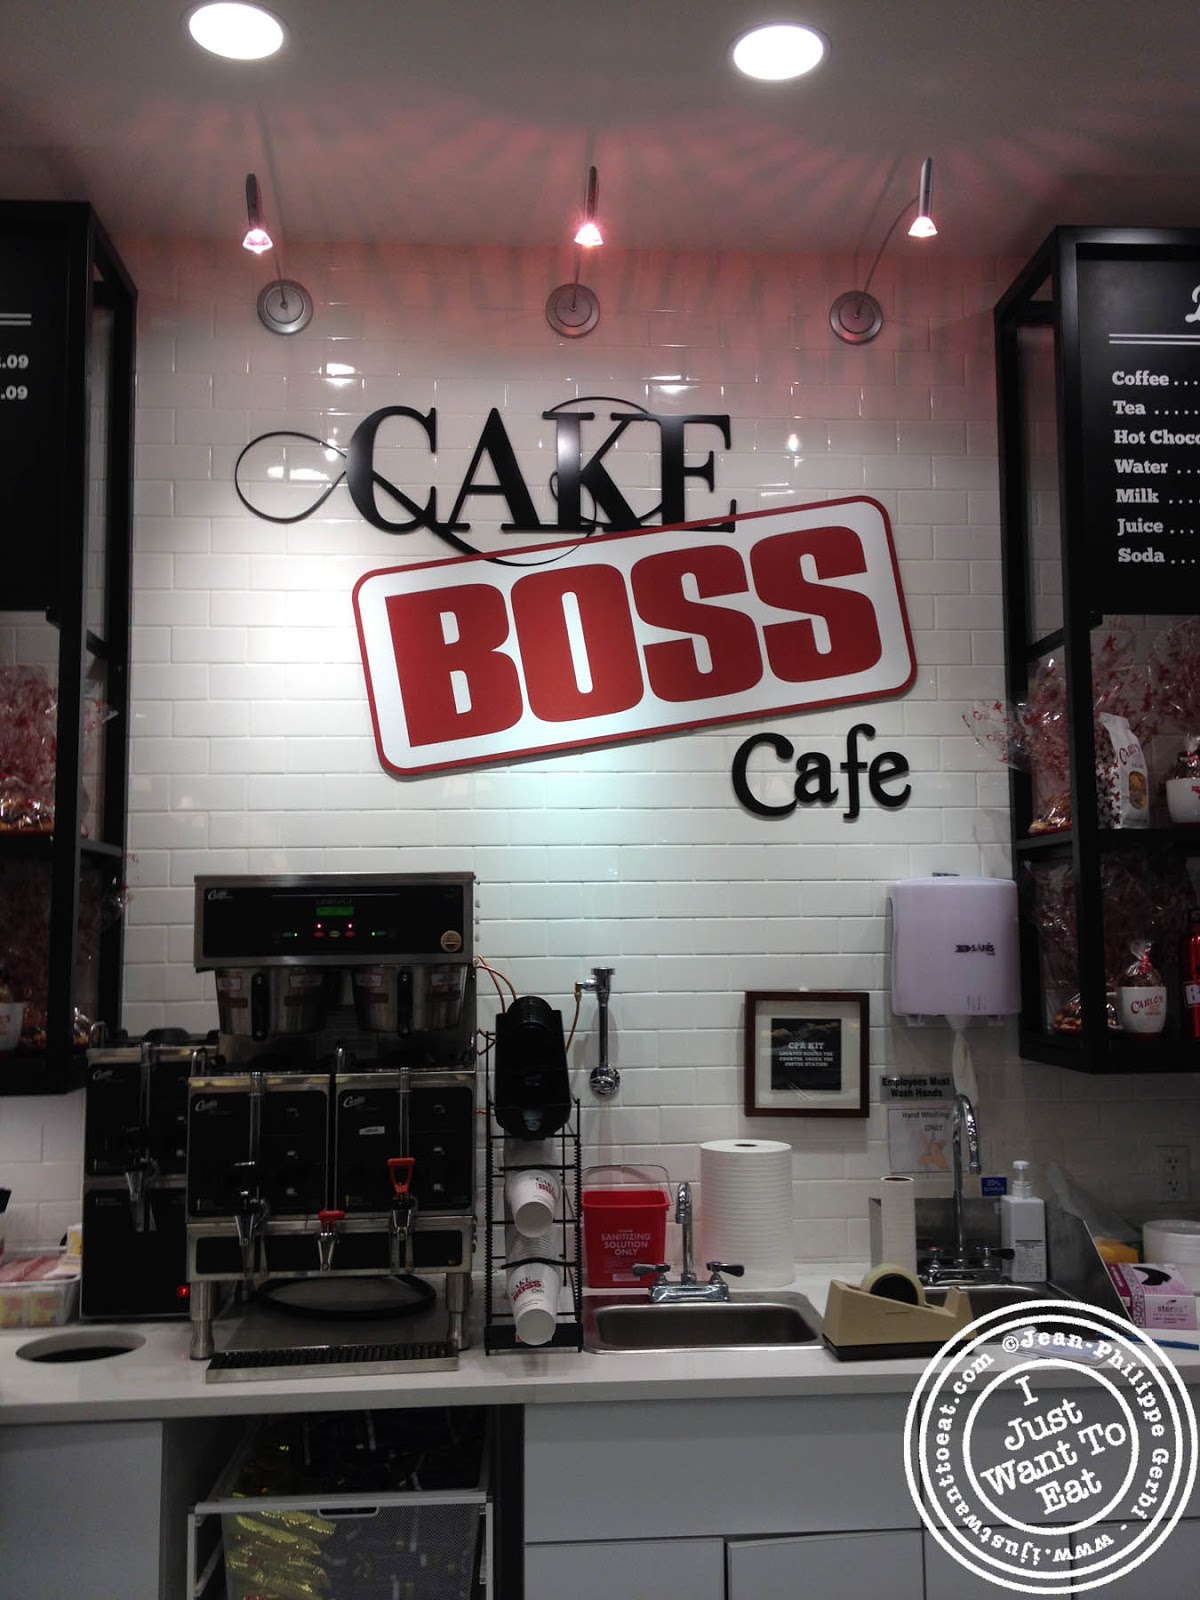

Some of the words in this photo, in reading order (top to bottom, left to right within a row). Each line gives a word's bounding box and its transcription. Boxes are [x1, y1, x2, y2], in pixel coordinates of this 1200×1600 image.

[0, 354, 29, 369] .09
[1112, 370, 1170, 386] Coffee
[1113, 400, 1147, 415] Tea
[1114, 429, 1146, 445] Hot
[344, 402, 737, 534] CAKE
[1114, 458, 1169, 474] Water
[1116, 488, 1160, 503] Milk
[1117, 518, 1164, 536] Juice
[1118, 547, 1166, 563] Soda
[384, 525, 882, 748] BOSS
[731, 723, 911, 820] Cafe
[787, 1042, 806, 1050] CPR
[808, 1042, 825, 1050] KIT
[882, 1077, 927, 1088] Employees
[929, 1077, 951, 1086] Must
[891, 1088, 913, 1098] Wash
[916, 1088, 943, 1098] Hands
[601, 1233, 652, 1241] SANITIZING
[604, 1241, 649, 1249] SOLUTION
[614, 1248, 639, 1256] ONLY
